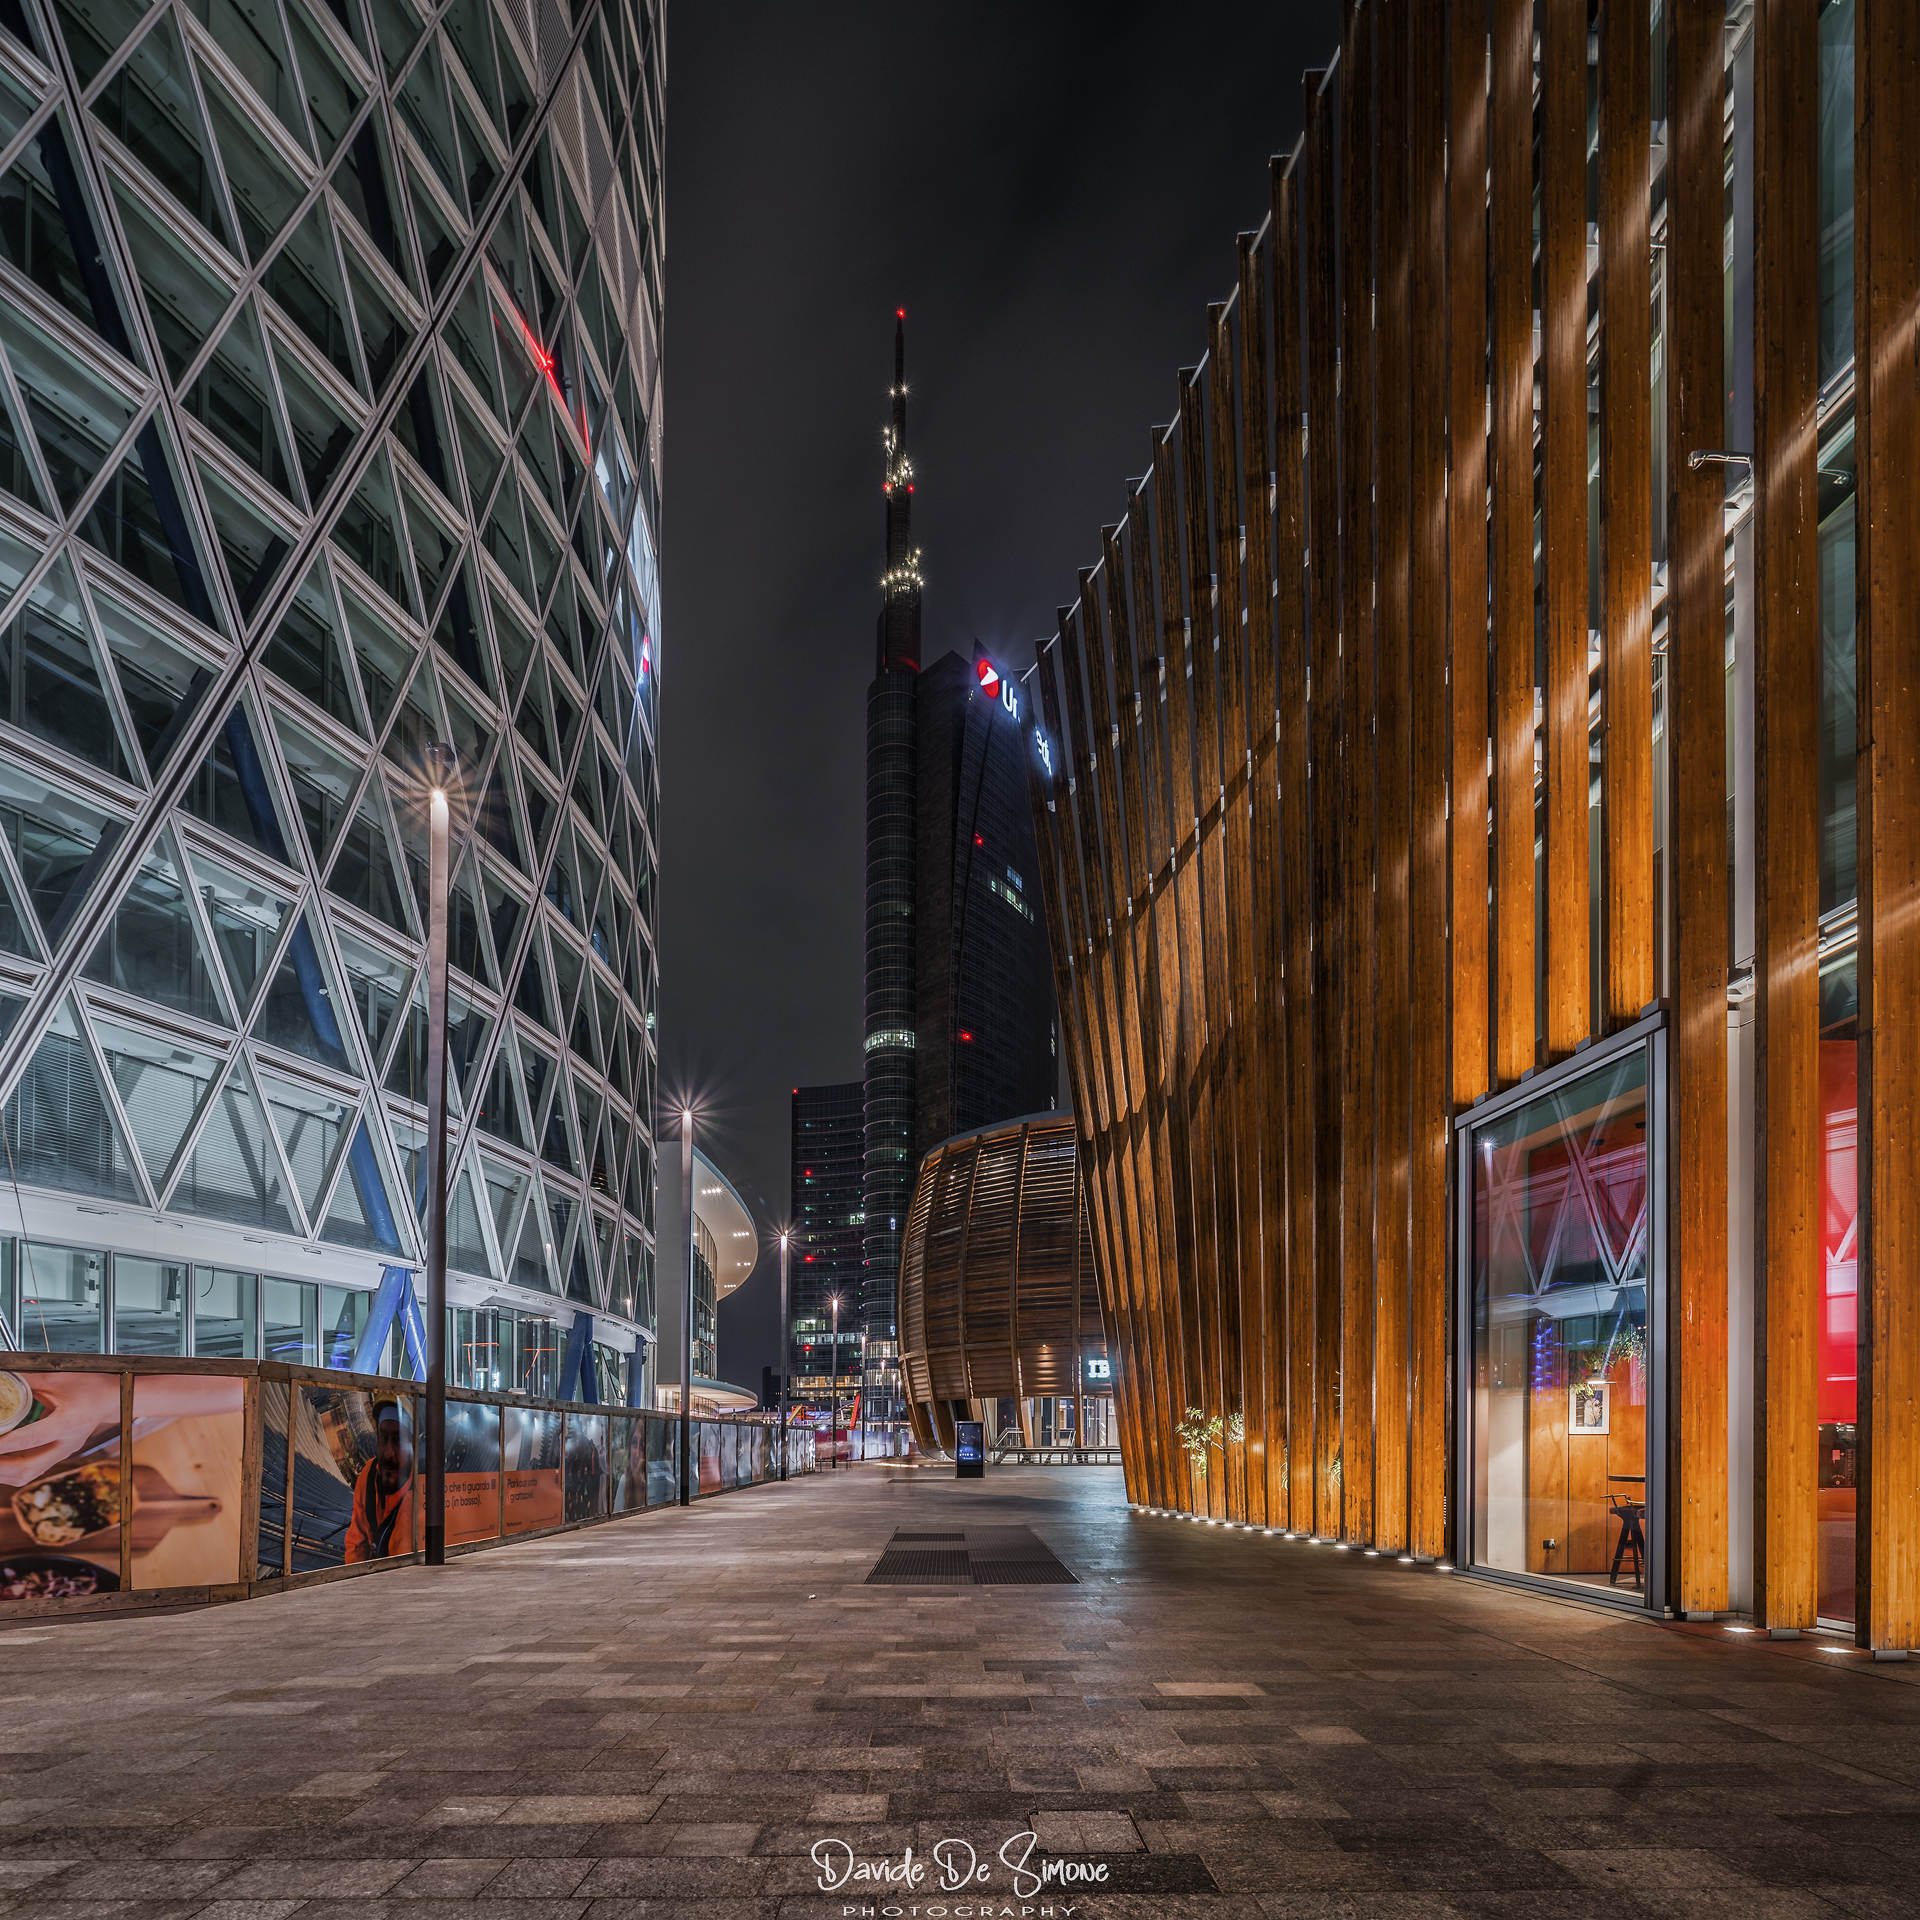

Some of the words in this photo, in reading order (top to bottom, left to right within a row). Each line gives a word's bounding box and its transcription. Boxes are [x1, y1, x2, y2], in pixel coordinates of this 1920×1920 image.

[1088, 1359, 1111, 1379] IB
[448, 1481, 461, 1493] che
[462, 1481, 467, 1492] ti
[467, 1480, 490, 1494] guarda
[507, 1478, 527, 1489] Parkour
